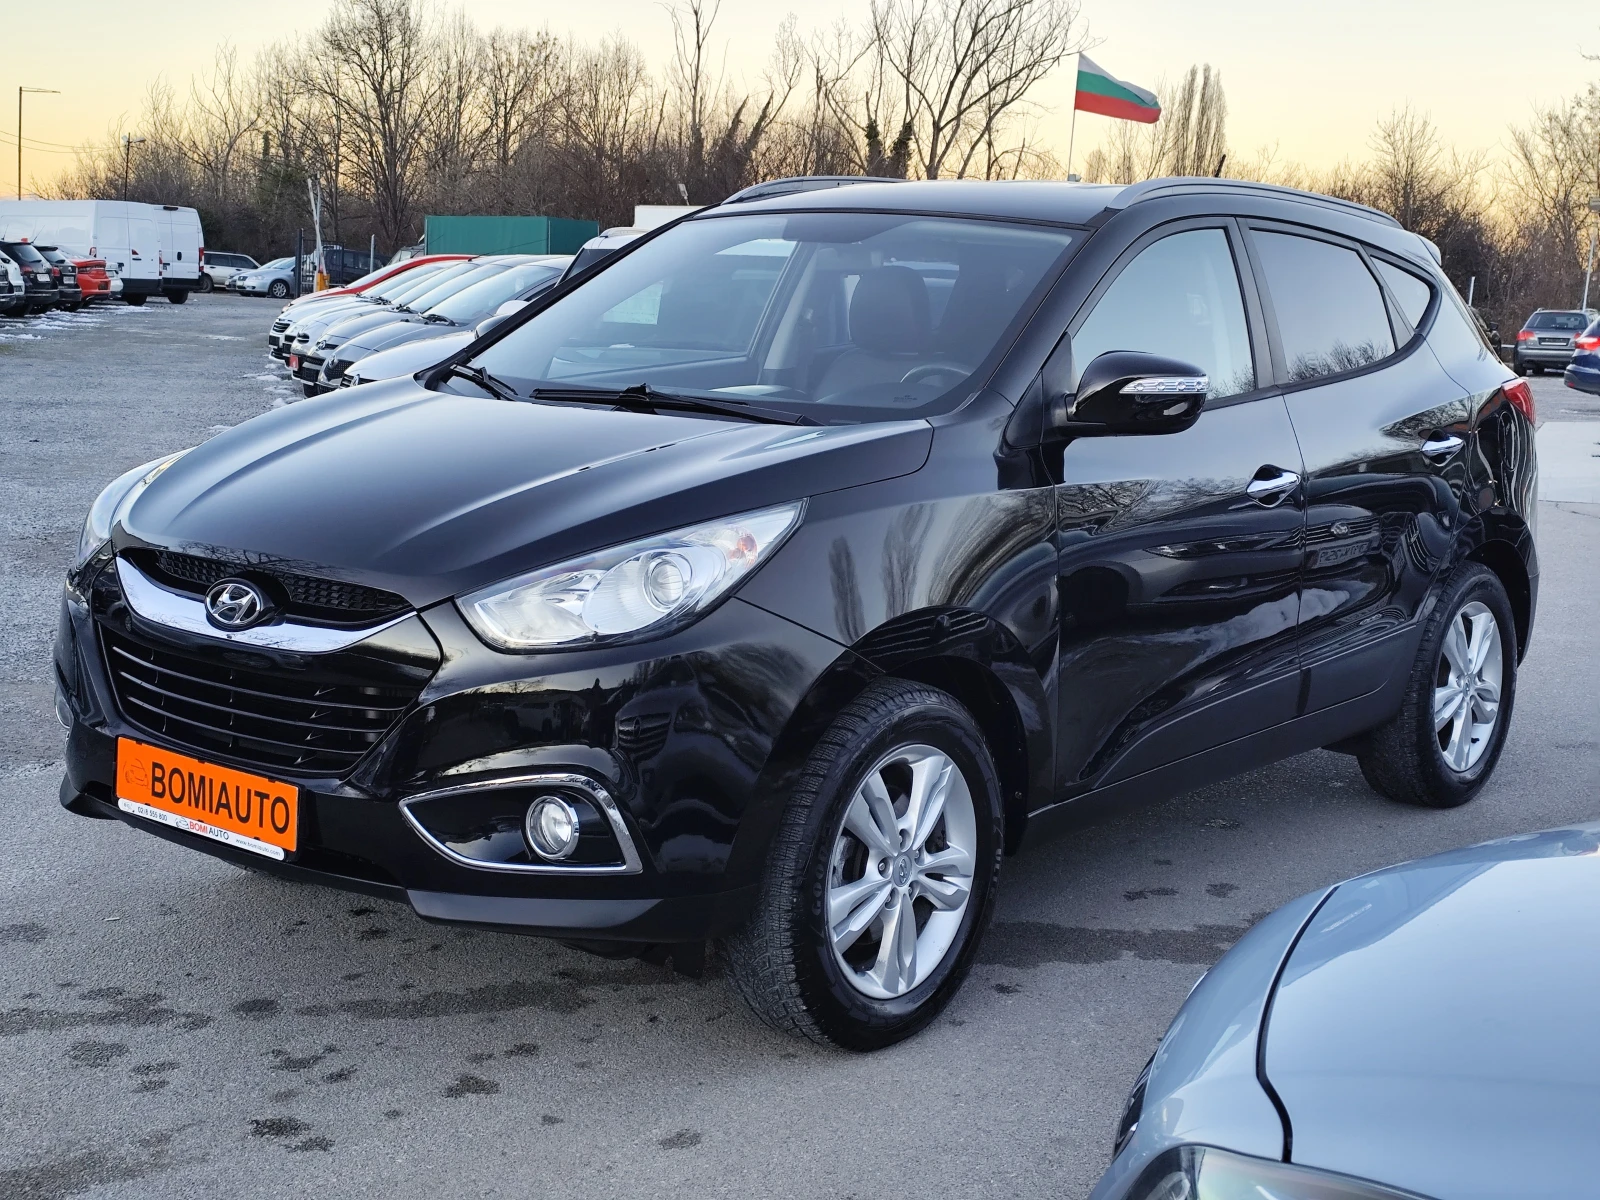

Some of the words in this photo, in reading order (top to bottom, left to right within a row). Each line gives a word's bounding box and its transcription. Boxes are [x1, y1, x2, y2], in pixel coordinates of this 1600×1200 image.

[151, 761, 290, 835] BOMIAUTO
[189, 820, 208, 835] BOMI
[208, 827, 230, 841] AUTO
